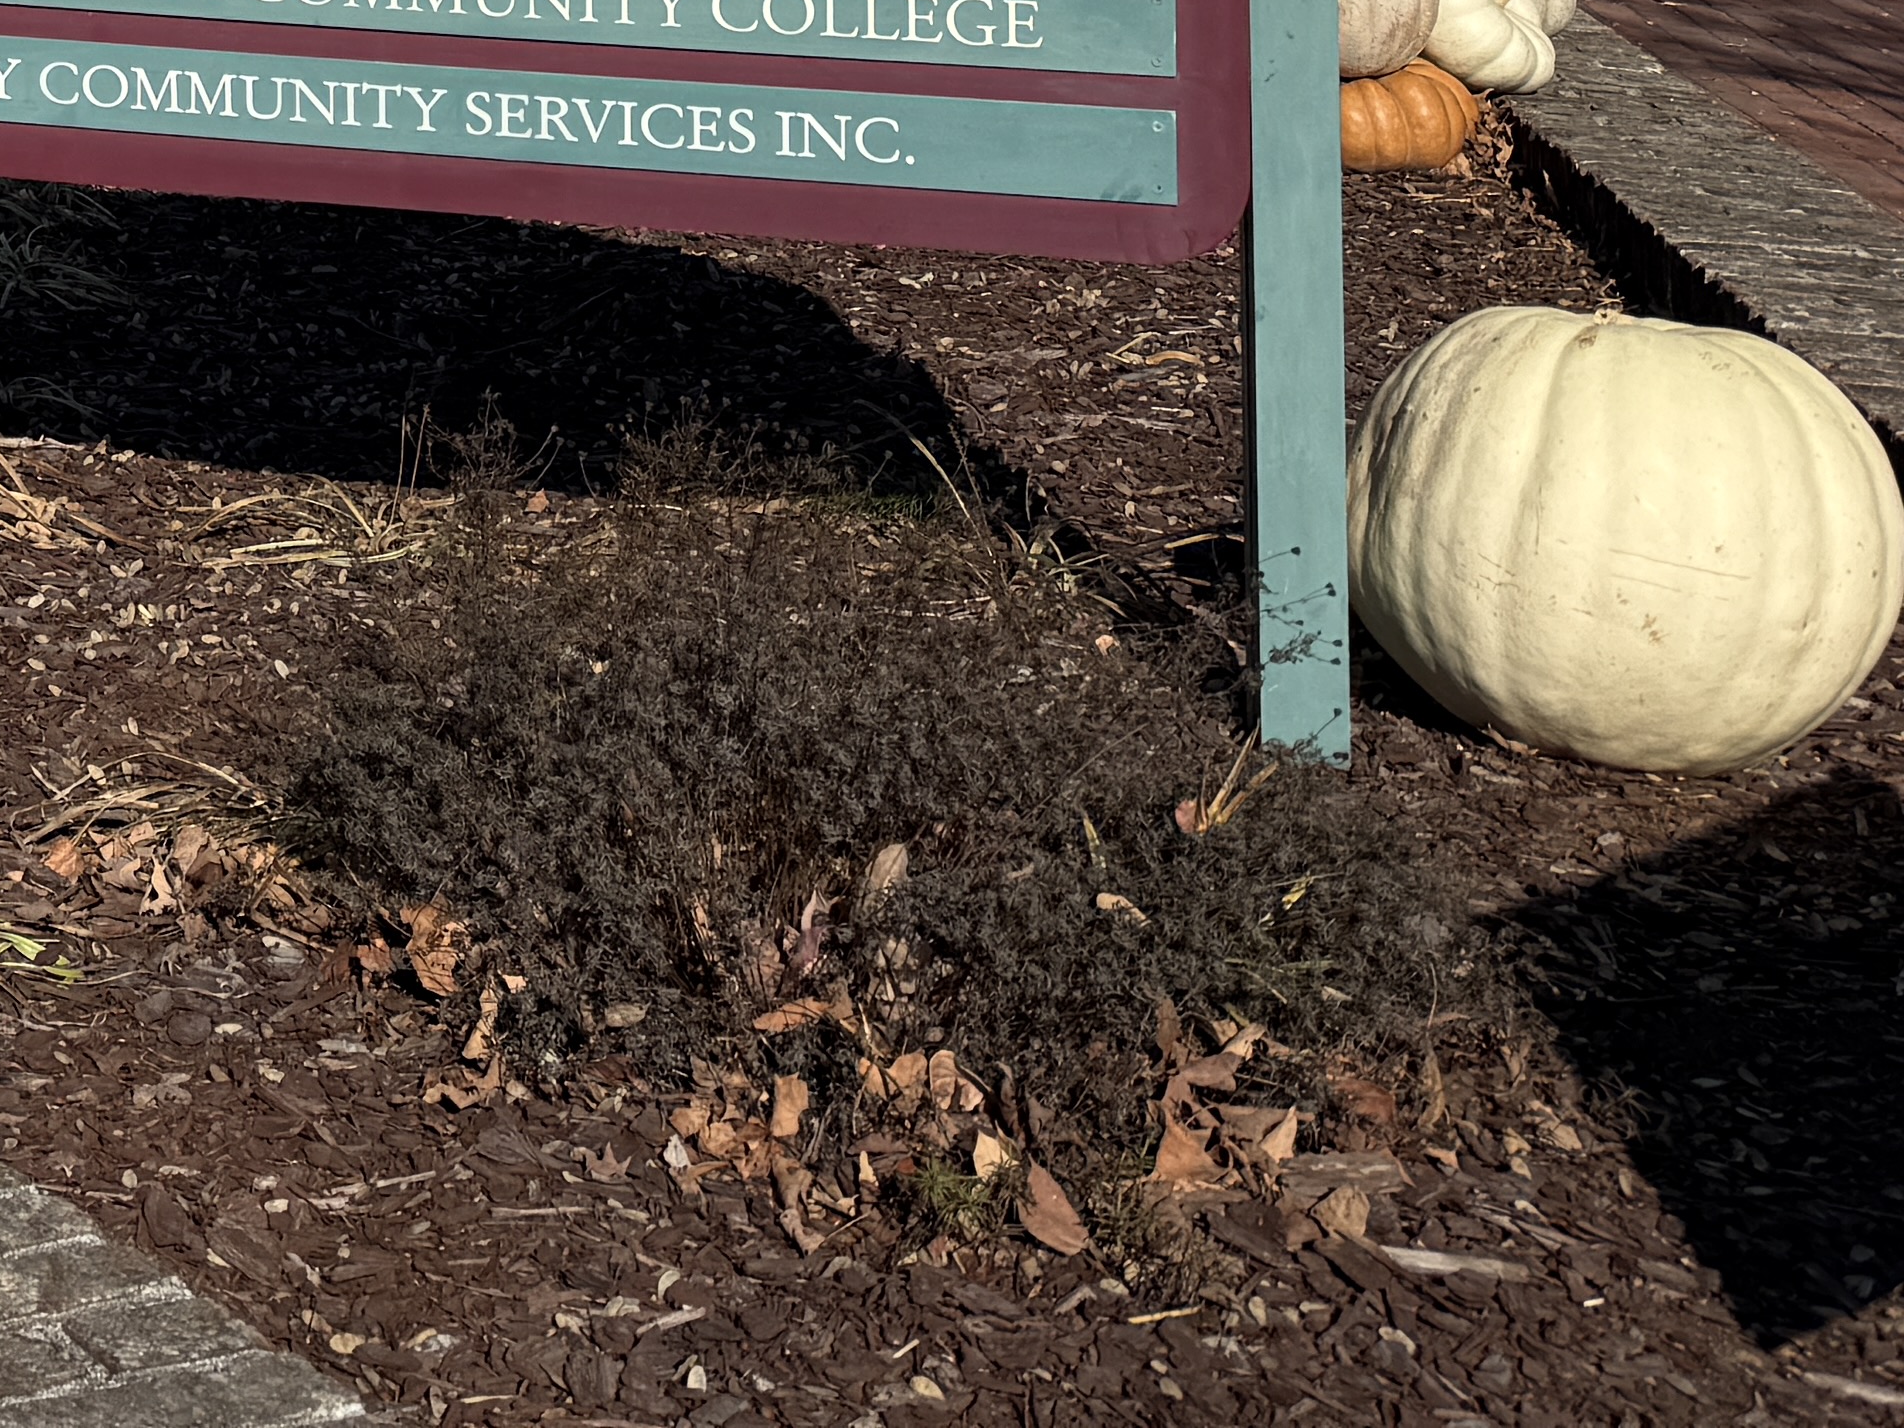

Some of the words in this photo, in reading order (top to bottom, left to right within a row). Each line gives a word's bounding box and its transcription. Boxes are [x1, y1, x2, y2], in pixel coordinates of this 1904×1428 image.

[39, 61, 448, 132] COMMUNITY
[465, 91, 756, 154] SERVICES
[774, 110, 915, 165] INC.
